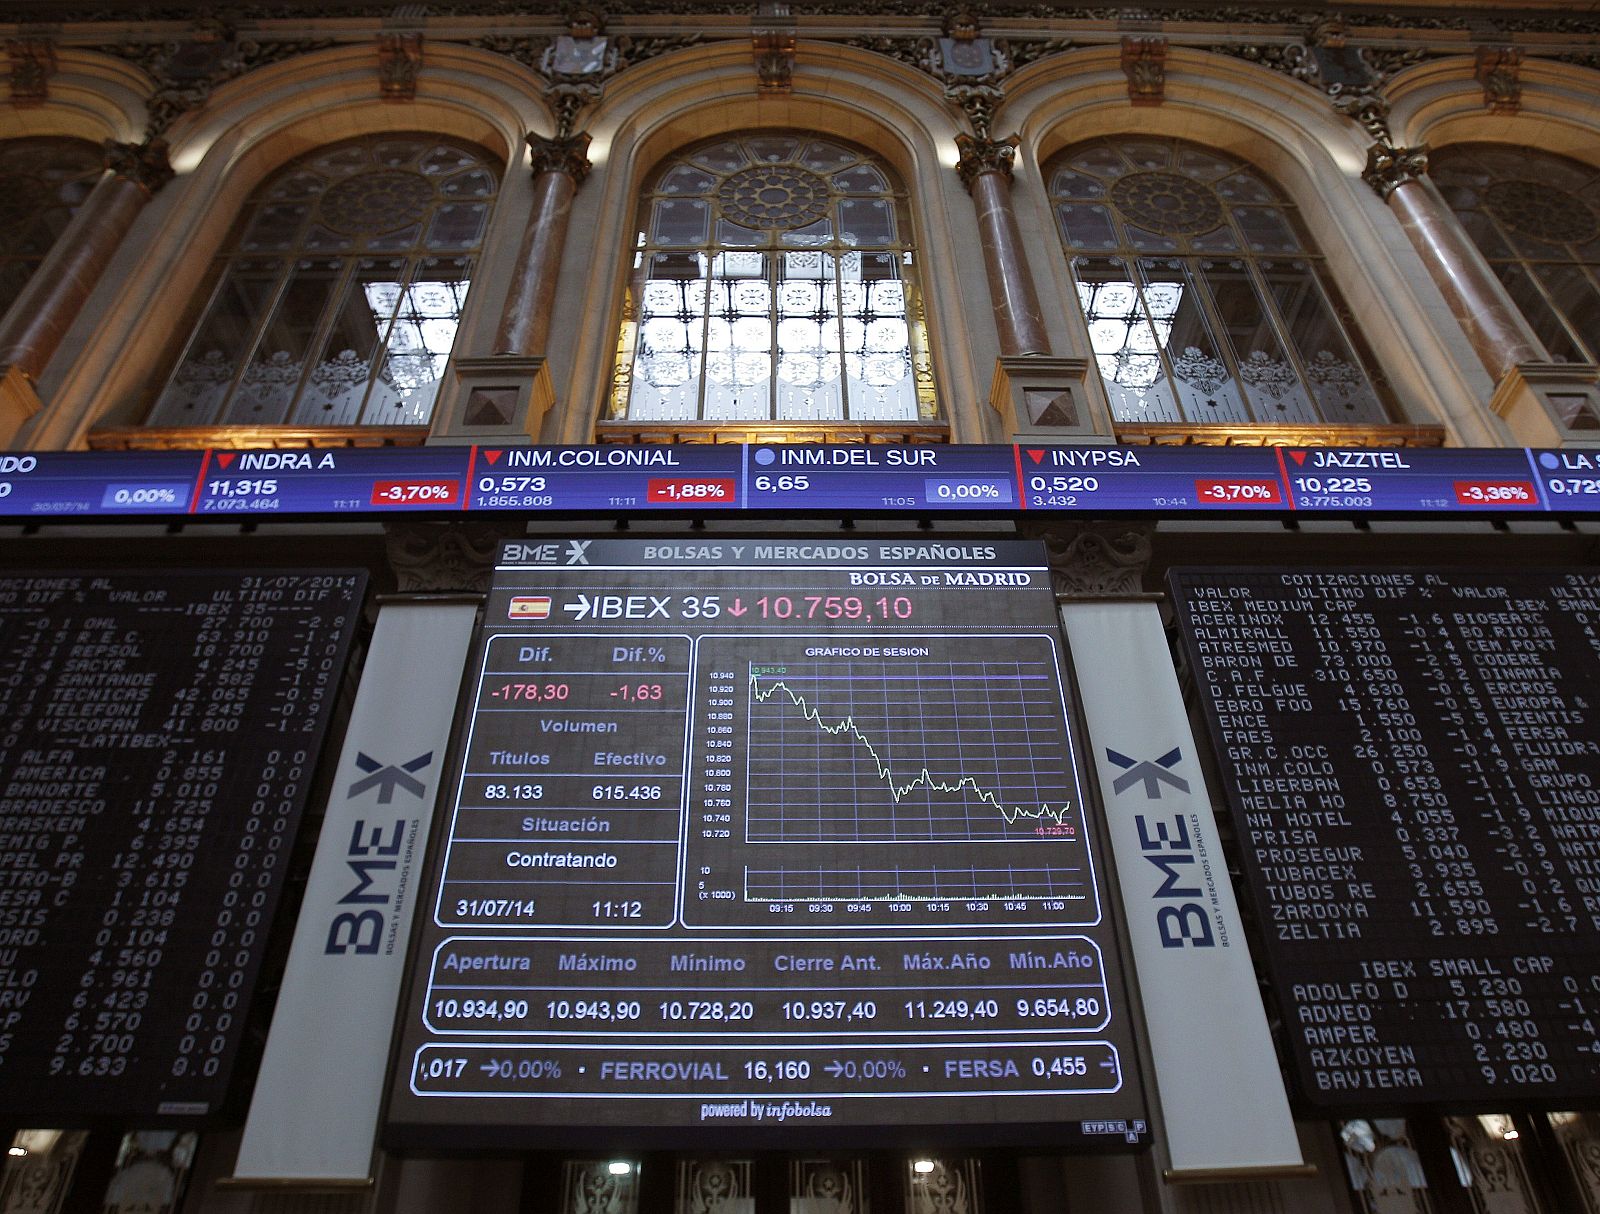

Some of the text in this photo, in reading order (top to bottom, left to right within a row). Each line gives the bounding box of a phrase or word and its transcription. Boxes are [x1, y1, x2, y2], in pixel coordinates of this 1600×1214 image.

[239, 453, 336, 470] INDRA A
[507, 450, 680, 467] INM.COLONIAL
[781, 449, 937, 465] INM.DEL SUR
[1052, 450, 1141, 467] INYPSA
[1313, 452, 1410, 469] JAZZTEL
[1562, 454, 1594, 470] LA
[209, 479, 278, 498] 11,315
[479, 477, 546, 495] 0,573
[657, 484, 725, 500] -1,88%
[755, 475, 810, 493] 6,65
[1030, 476, 1099, 494] 0,520
[1295, 477, 1372, 495] 10,225
[114, 489, 176, 505] 0,00%
[379, 486, 450, 502] -3,70%
[937, 484, 999, 501] 0,00%
[1033, 495, 1078, 506] 3.432
[1204, 485, 1271, 501] -3,70%
[1462, 485, 1529, 502] -3,36%
[204, 498, 279, 510] 7.073.464
[477, 496, 553, 507] 1.855.808
[608, 497, 636, 506] 11:11
[881, 497, 915, 506] 11:05
[1152, 497, 1187, 506] 10:44
[1300, 496, 1373, 507] 3.775.003
[502, 544, 560, 562] BME
[643, 544, 996, 560] BOLSAS Y MERCADOS ESPAÑOLES
[849, 572, 917, 586] BOLSA
[944, 572, 1031, 586] MADRID
[1281, 574, 1449, 586] COTIZACIONES AL
[1194, 587, 1365, 599] VALOR ULTIMO
[592, 596, 913, 623] IBEX 35 10.759,10
[1188, 600, 1358, 612] IBEX MEDIUM CAP
[1190, 613, 1376, 626] ACERINOX 12.455
[1195, 627, 1289, 640] ALMIRALL
[518, 647, 666, 663] Dif. Dif.%
[863, 647, 881, 657] DE
[883, 647, 929, 657] SESION
[1198, 641, 1293, 653] ATRESMED
[1202, 655, 1299, 668] BARON DE
[709, 672, 735, 680] 10.940
[491, 684, 663, 703] -178,30 -1,63
[1211, 684, 1308, 698] D.FELGUE
[540, 720, 618, 733] Volumen
[1219, 714, 1269, 728] ENCE
[706, 740, 732, 748] 10.840
[489, 751, 667, 766] Títulos Efectivo
[705, 755, 731, 763] 10.820
[1233, 761, 1334, 776] INM.COLO
[485, 784, 662, 800] 83.133 615.436
[704, 784, 731, 792] 10.780
[1236, 777, 1341, 793] LIBERBAN
[703, 799, 731, 807] 10.760
[521, 816, 611, 832] Situación
[703, 815, 731, 823] 10.740
[702, 830, 730, 838] 10.720
[1251, 830, 1318, 845] PRISA
[506, 851, 618, 868] Contratando
[1256, 847, 1364, 864] PROSEGUR
[700, 866, 711, 875] 10
[1260, 865, 1357, 882] TUBACEX
[324, 819, 406, 955] BME
[698, 881, 705, 889] 5
[1134, 814, 1216, 948] BME
[1201, 858, 1220, 906] MERCADOS
[456, 899, 642, 918] 31/07/14 11:12
[769, 902, 1065, 913] 09:15 09:30 09:45 10:00 10:15 10:30 10:45 11:00
[1271, 902, 1369, 920] ZARDOYA
[1215, 914, 1230, 948] BOLSAS
[1276, 922, 1363, 940] ZELTIA
[443, 952, 1093, 973] Apertura Máximo Mínimo Cierre Ant. Máx.Año Mín.Año
[434, 998, 1100, 1023] 10.934,90 10.943,90 10.728,20 10.937,40 11.249,40 9.654,80
[1298, 1003, 1372, 1023] ADVEO
[1304, 1025, 1380, 1045] AMPER
[420, 1056, 1087, 1083] ,017 0,00% FERROVIAL 16,160 0,00% FERSA 0,455
[1315, 1067, 1424, 1090] BAVIERA
[700, 1101, 833, 1122] powered by infobolsa
